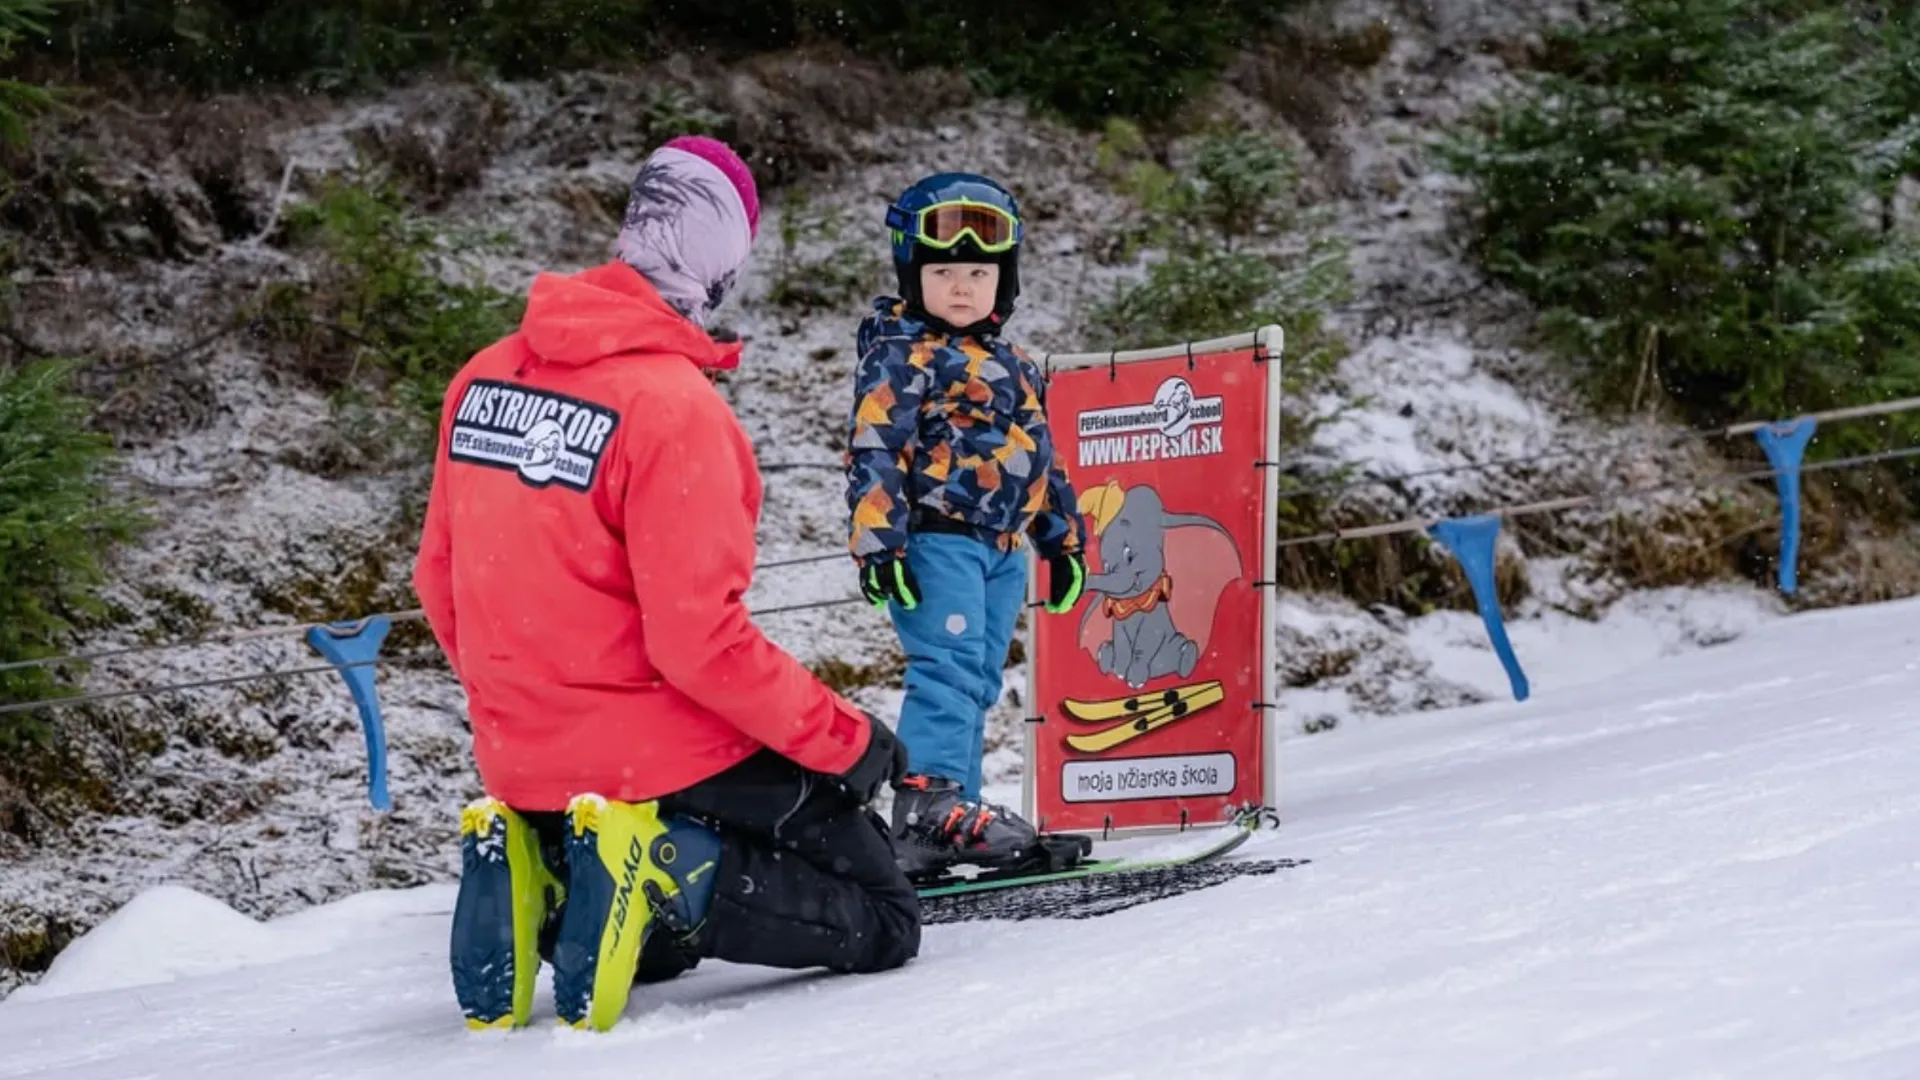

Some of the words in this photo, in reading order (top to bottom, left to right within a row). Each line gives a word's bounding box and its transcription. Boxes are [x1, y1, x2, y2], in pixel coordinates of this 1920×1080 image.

[457, 384, 613, 454] INSTRUCTOR
[1190, 402, 1221, 420] school
[1078, 426, 1224, 467] WWW.PEPESKI.SK
[554, 455, 589, 479] school
[1078, 770, 1113, 793] moja
[1118, 767, 1177, 791] lyžiarska
[1181, 764, 1218, 786] škola
[607, 834, 643, 962] DYNAF
